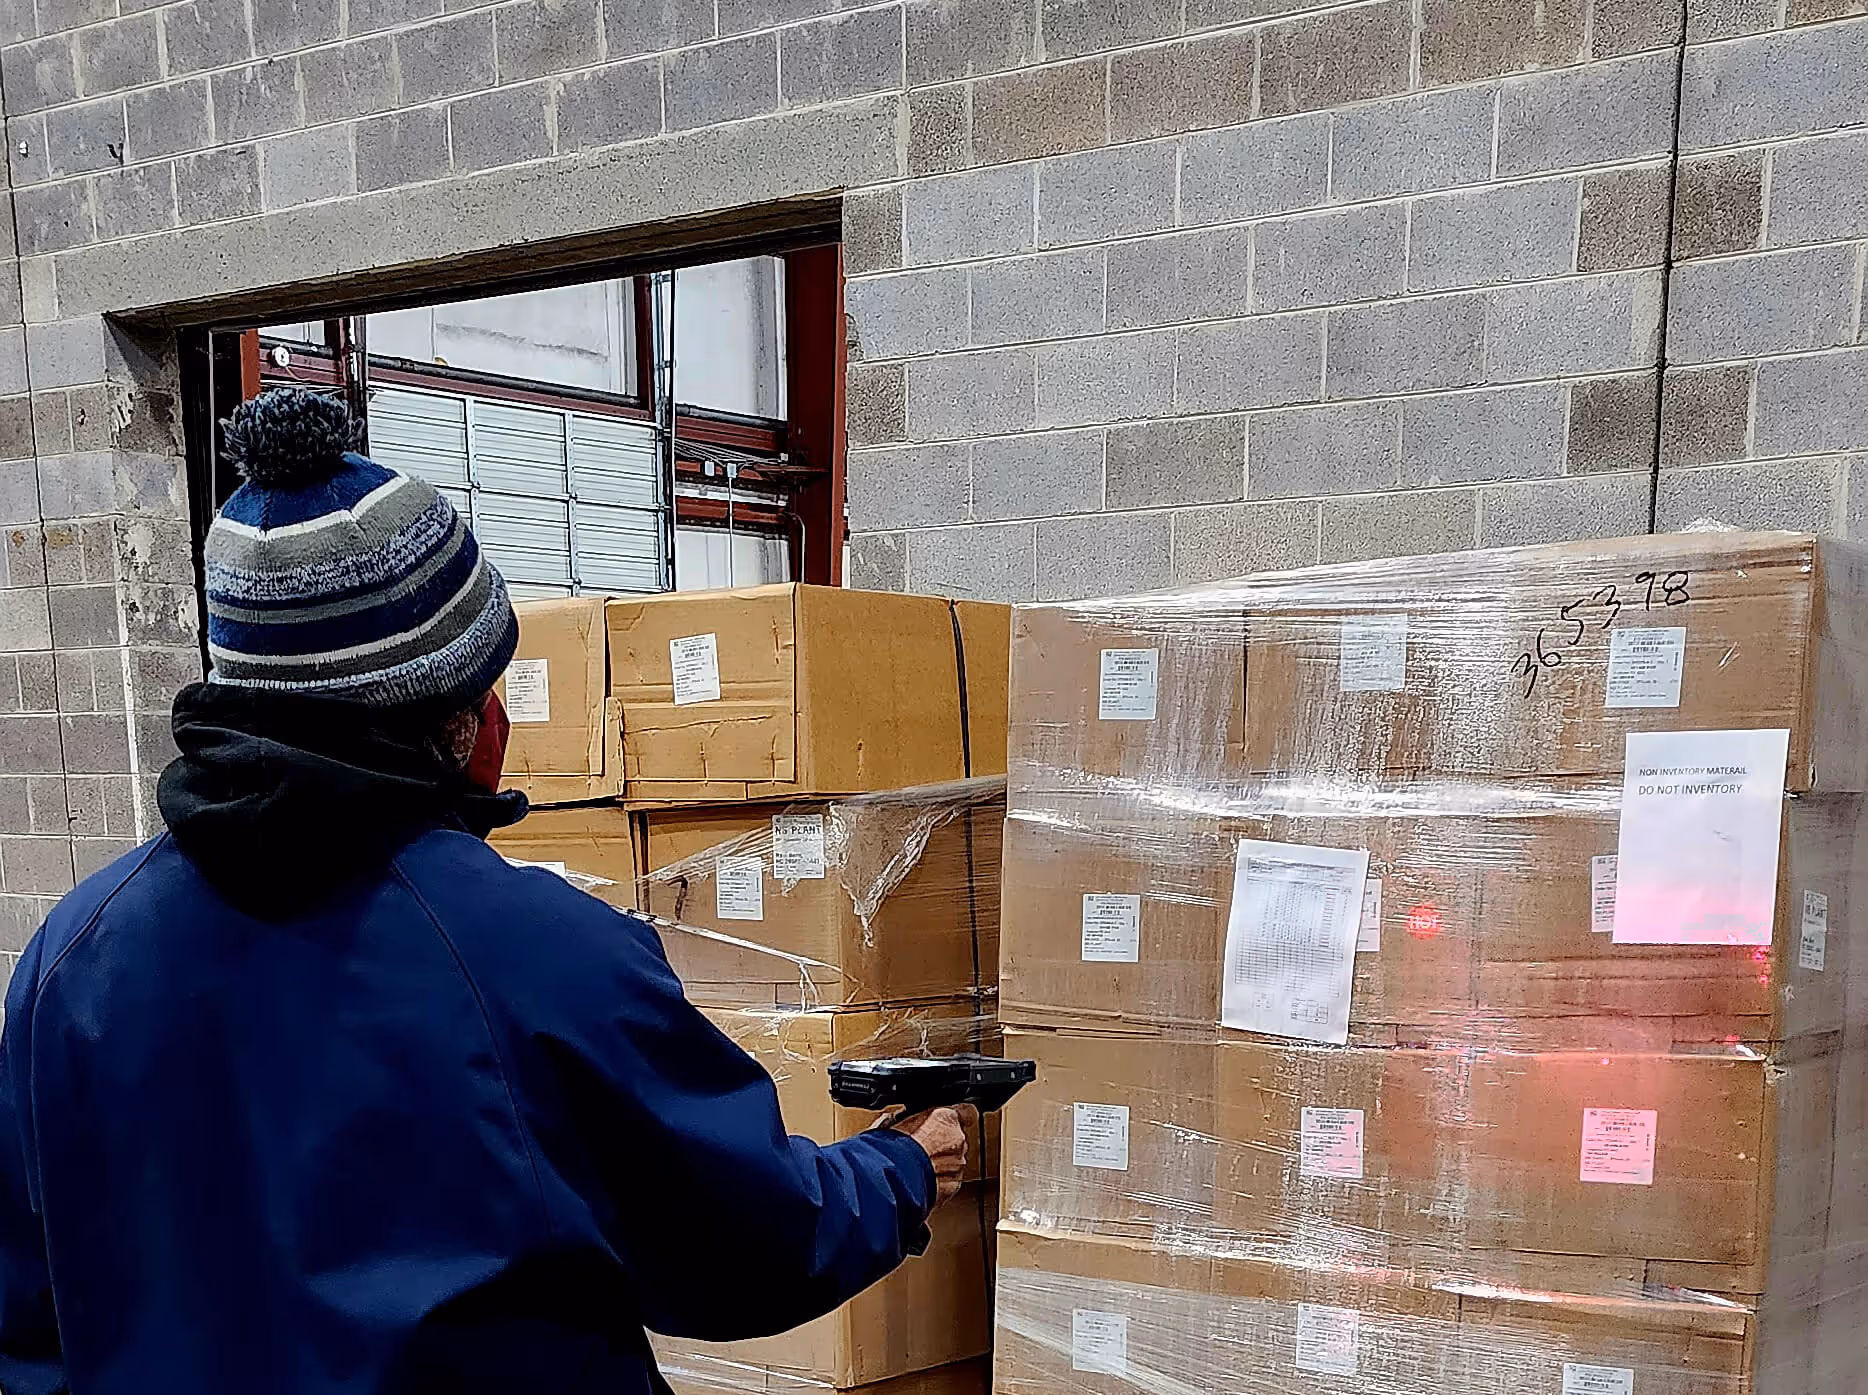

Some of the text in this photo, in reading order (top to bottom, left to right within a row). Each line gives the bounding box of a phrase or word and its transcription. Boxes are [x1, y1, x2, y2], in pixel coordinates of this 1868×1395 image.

[1510, 570, 1691, 699] 365398
[1639, 767, 1658, 777] NON
[1659, 766, 1705, 776] INVENTORY
[1638, 783, 1743, 796] DO NOT INVENTORY
[791, 824, 822, 835] PLANT
